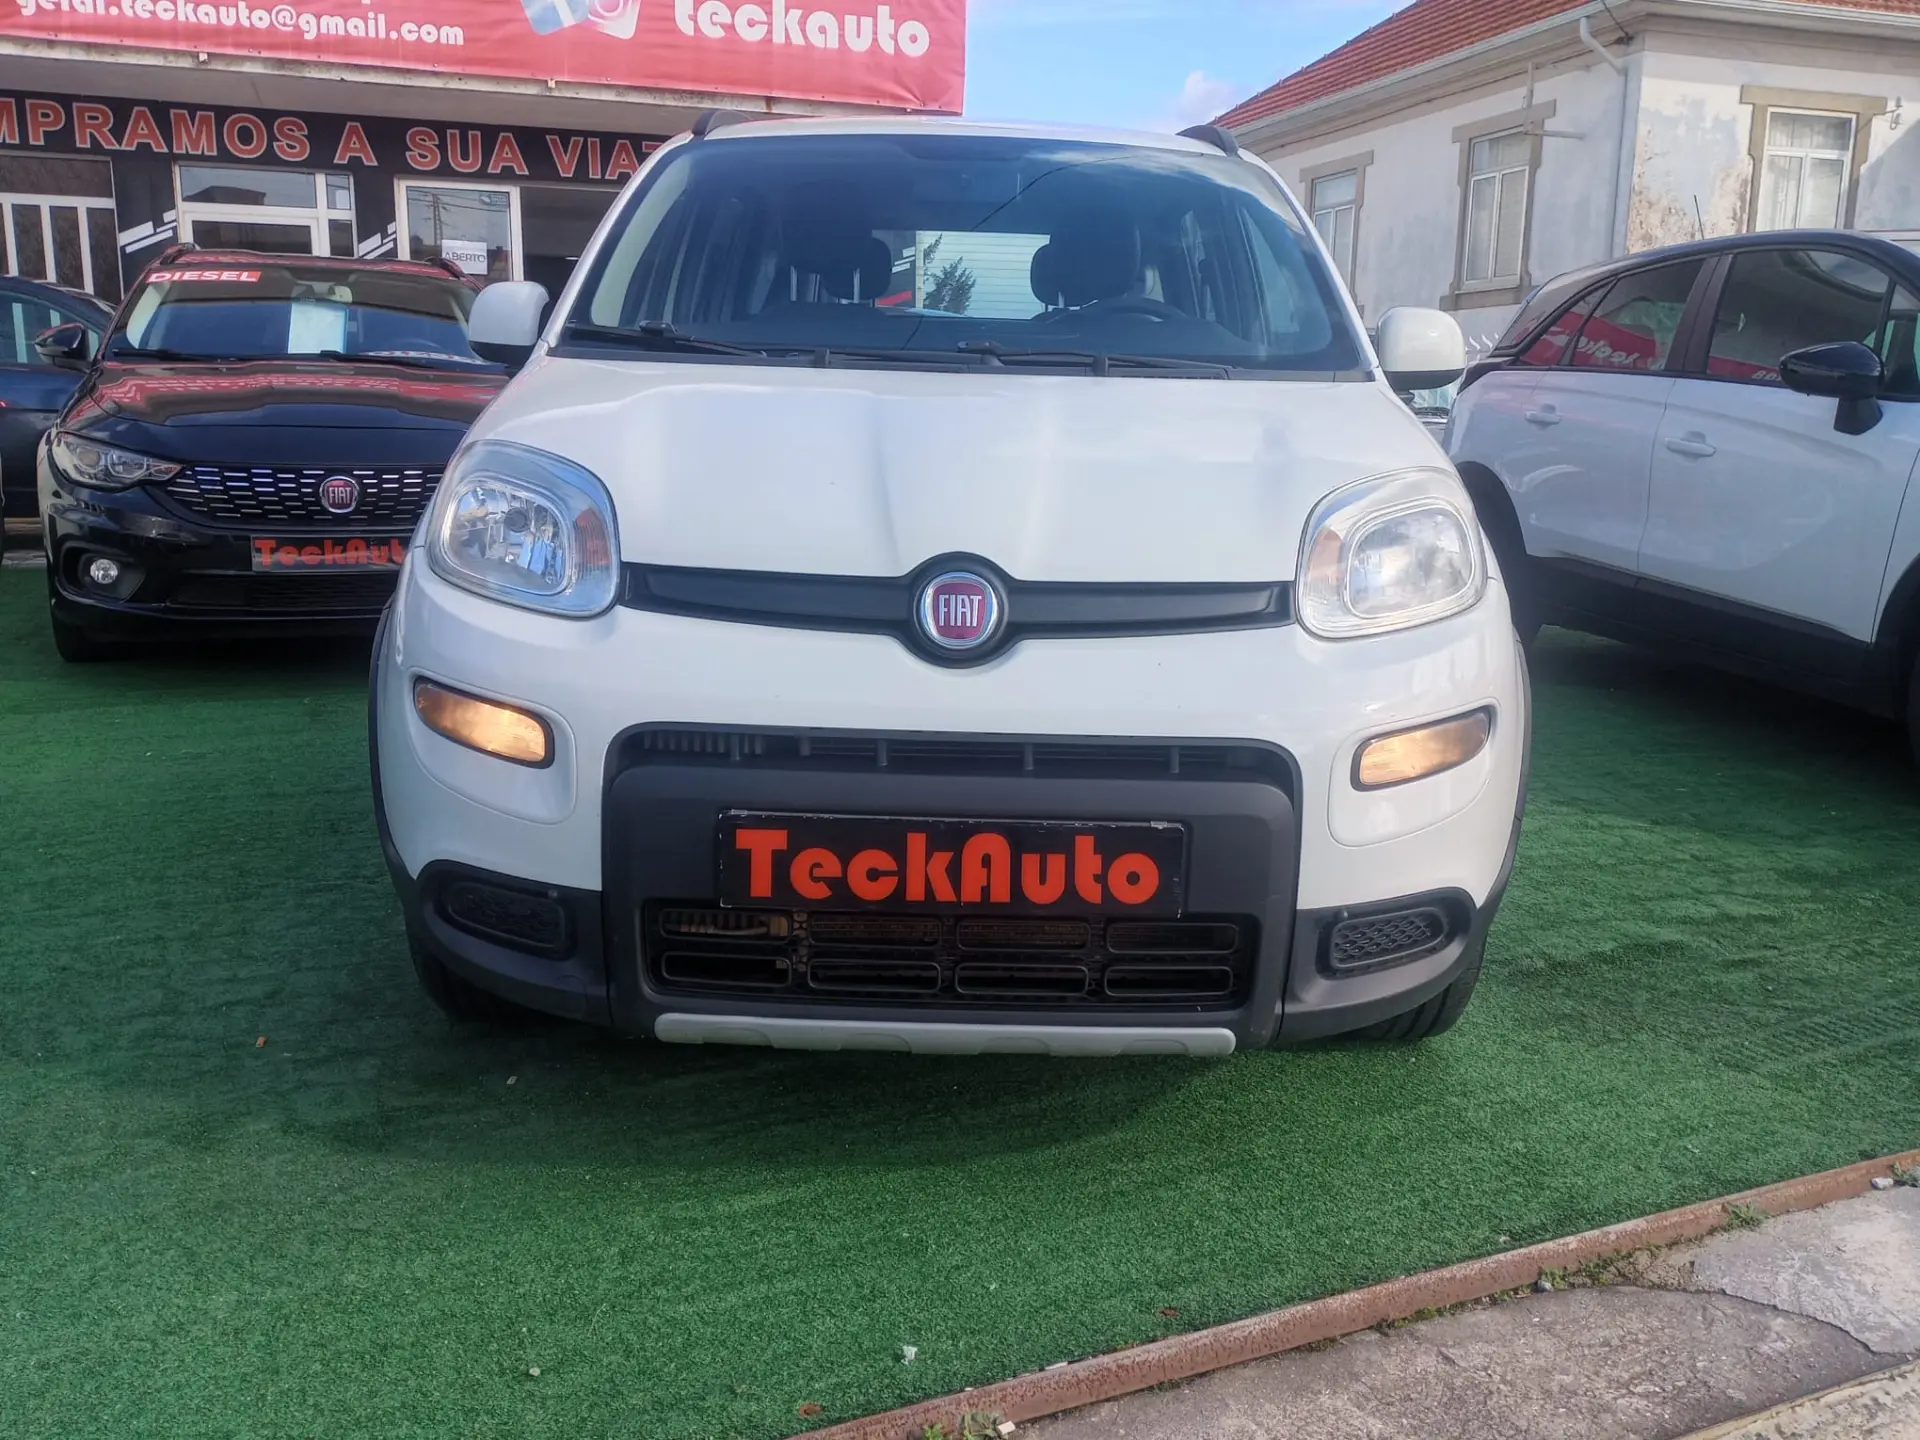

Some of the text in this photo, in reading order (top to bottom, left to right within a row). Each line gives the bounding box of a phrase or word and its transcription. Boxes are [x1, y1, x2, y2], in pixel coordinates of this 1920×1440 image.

[674, 0, 931, 58] teckauto
[333, 121, 379, 167] A
[405, 126, 530, 175] SUA
[443, 250, 487, 264] ABERTO
[147, 270, 258, 282] DIESEL
[328, 486, 352, 505] FIAT
[254, 538, 406, 568] TeckAut
[938, 594, 983, 628] FIAT
[735, 829, 1160, 905] TeckAuto
